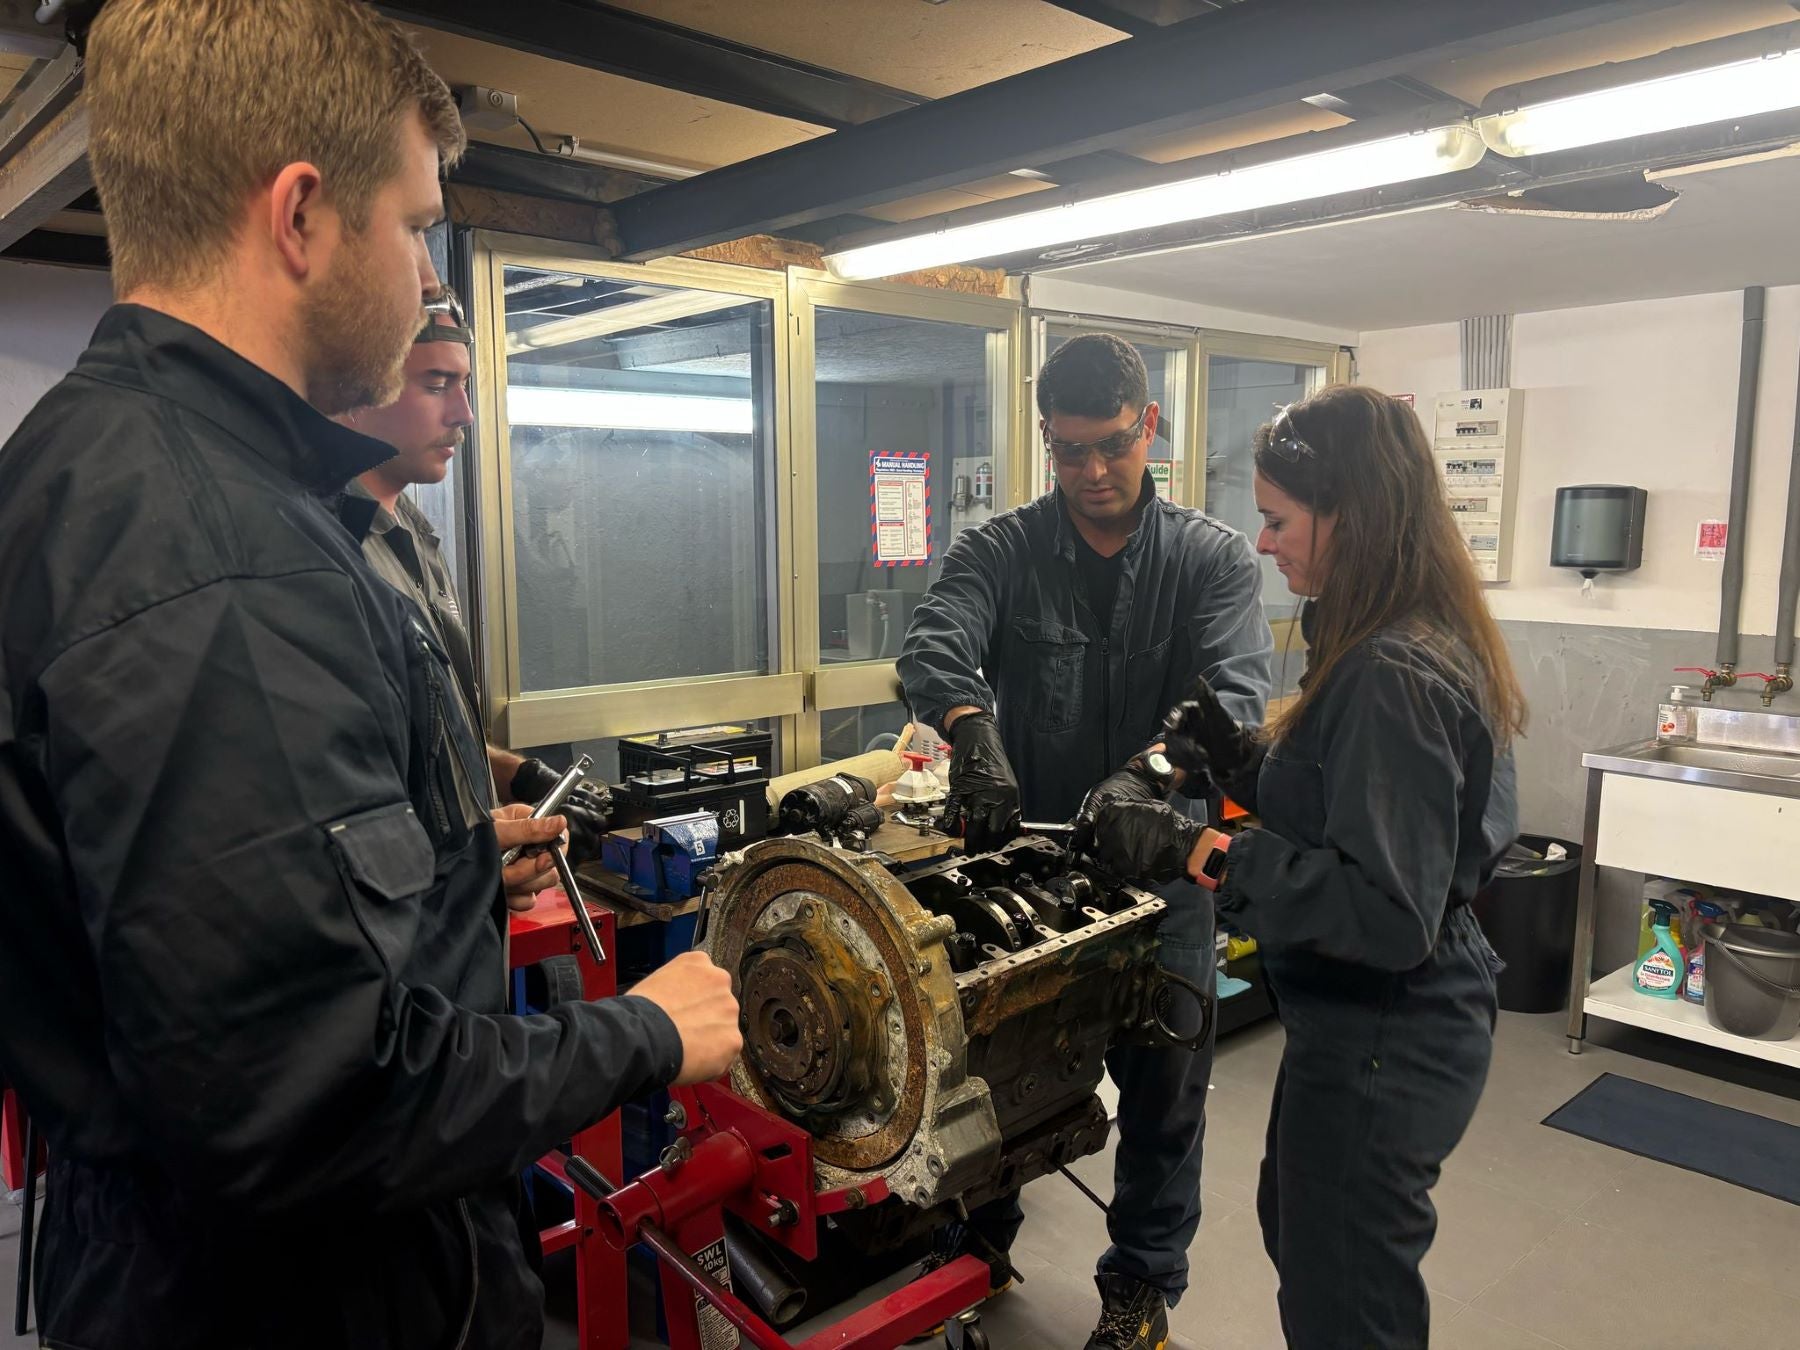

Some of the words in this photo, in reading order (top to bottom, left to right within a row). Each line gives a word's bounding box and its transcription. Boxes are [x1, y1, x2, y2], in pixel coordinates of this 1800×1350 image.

[697, 843, 703, 853] 5
[1644, 966, 1672, 976] SANYTOL
[697, 1245, 722, 1265] SWL
